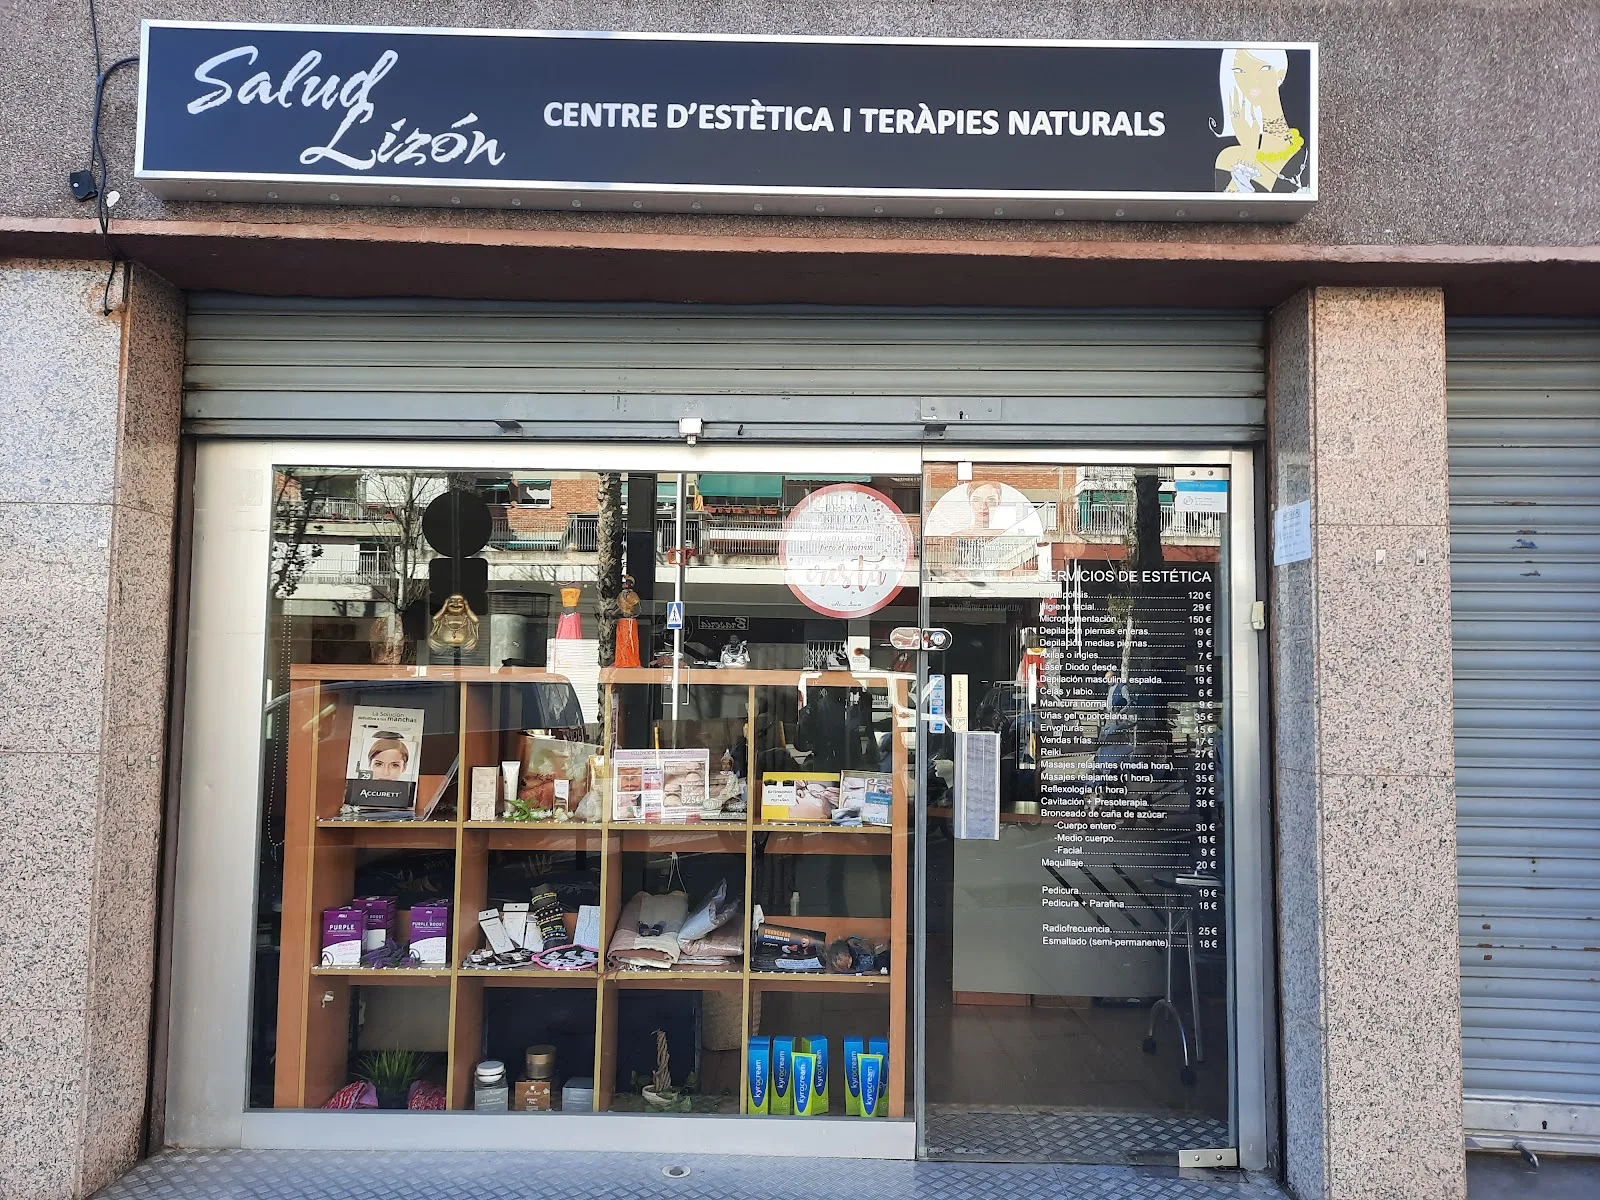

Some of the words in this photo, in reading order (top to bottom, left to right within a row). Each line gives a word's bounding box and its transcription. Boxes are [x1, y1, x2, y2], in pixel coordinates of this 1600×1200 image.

[187, 45, 398, 114] Salud
[543, 101, 656, 128] CENTRE
[665, 98, 834, 132] D'ESTÈTICA
[842, 106, 851, 132] I
[860, 103, 999, 135] TERÀPIES
[1007, 109, 1165, 136] NATURALS
[299, 102, 506, 170] Lizón
[824, 515, 870, 524] BELLEZA
[1119, 571, 1138, 582] DE
[1142, 569, 1212, 583] ESTÉTICA
[1040, 627, 1082, 636] Depilación
[1086, 628, 1115, 636] piernas
[1040, 639, 1082, 648] Depilación
[1117, 640, 1147, 649] piernas
[1074, 651, 1098, 661] ingles
[1040, 676, 1083, 685] Depilación
[1129, 676, 1162, 686] espalda
[1040, 688, 1063, 697] Cejas
[1064, 712, 1077, 722] gel
[1086, 713, 1127, 722] porcelana
[1194, 750, 1207, 758] 27
[1041, 761, 1075, 771] Masajes
[1078, 762, 1118, 771] relajantes
[1120, 761, 1149, 770] (media
[1151, 762, 1173, 771] hora)
[1041, 773, 1075, 783] Masajes
[1078, 774, 1118, 783] relajantes
[1121, 774, 1129, 783] (1
[1132, 774, 1153, 783] hora)
[1041, 785, 1092, 795] Reflexología
[1094, 786, 1103, 795] (1
[1105, 786, 1128, 794] hora)
[1041, 797, 1084, 806] Cavitación
[1094, 798, 1148, 808] Presoterapia
[1137, 810, 1168, 819] azúcar:
[1085, 836, 1114, 844] cuerpo
[1042, 859, 1083, 868] Maquillaje
[1090, 900, 1124, 908] Parafina
[1043, 924, 1110, 933] Radiofrecuencia
[1043, 937, 1086, 945] Esmaltado
[1089, 938, 1168, 948] (semi-permanente)
[778, 1051, 787, 1089] kyrocream
[754, 1059, 764, 1098] kyrocream
[798, 1064, 808, 1103] kyrocream
[865, 1066, 875, 1105] kyrocream
